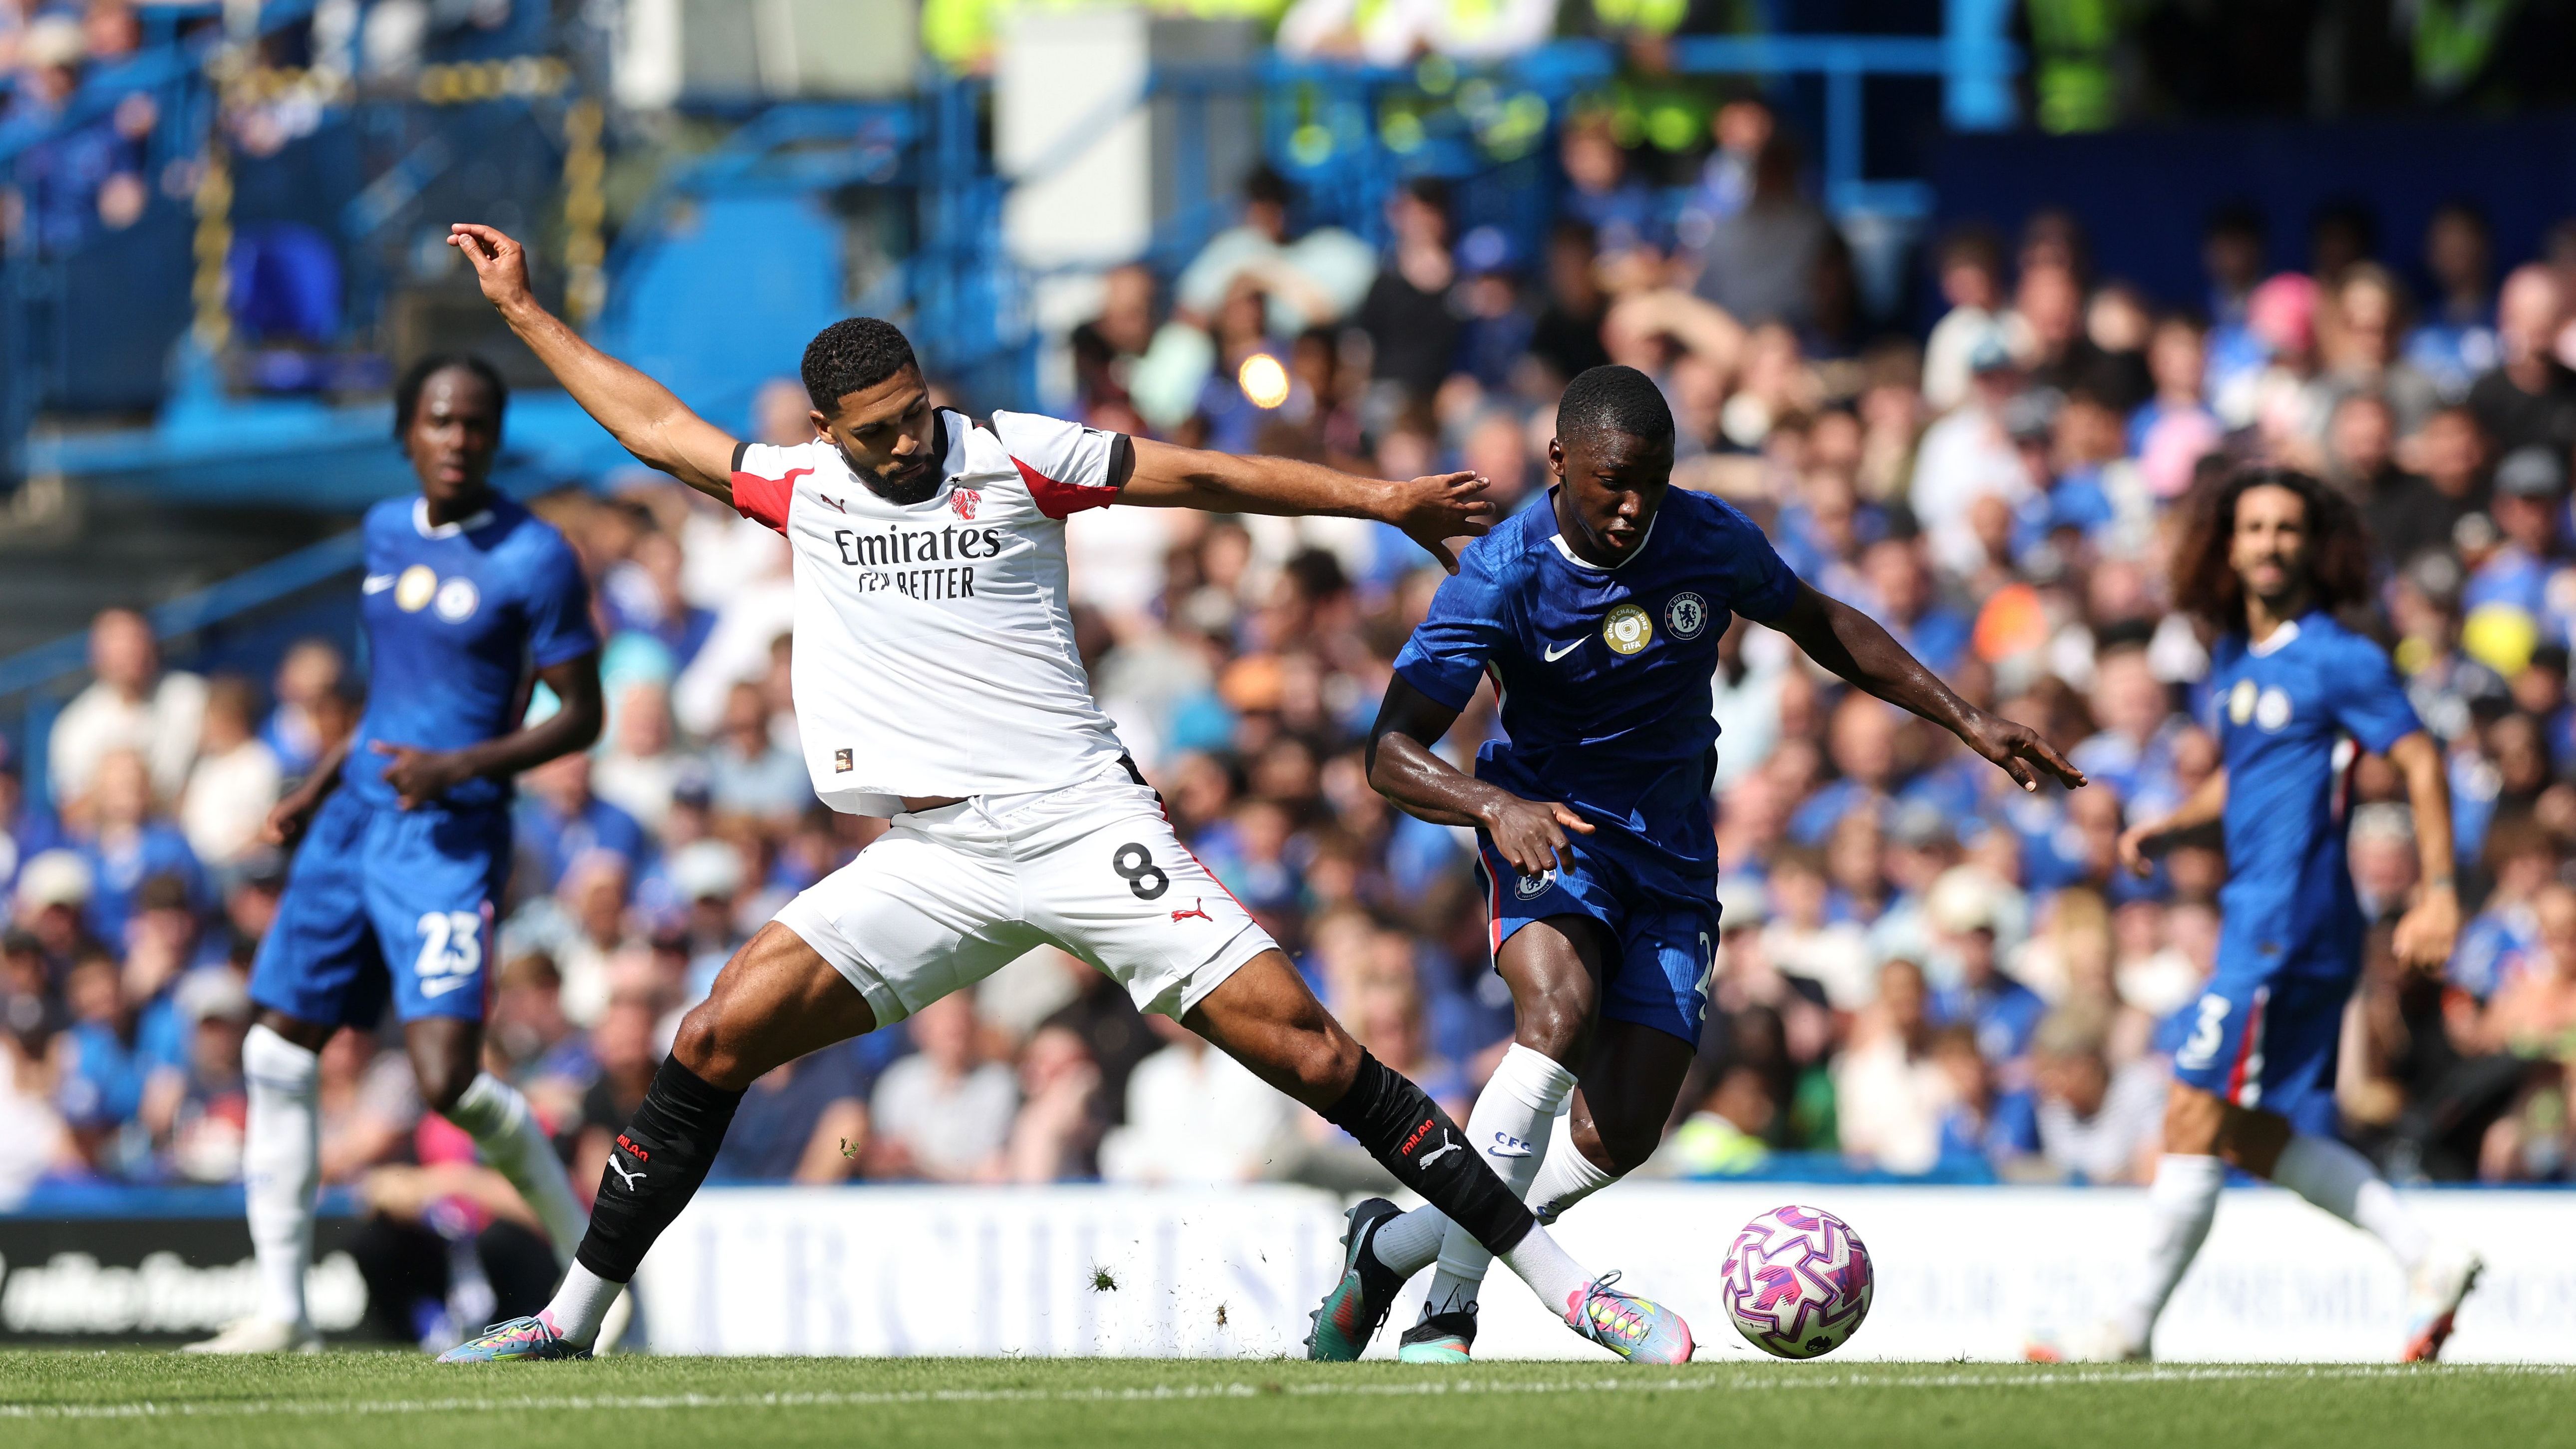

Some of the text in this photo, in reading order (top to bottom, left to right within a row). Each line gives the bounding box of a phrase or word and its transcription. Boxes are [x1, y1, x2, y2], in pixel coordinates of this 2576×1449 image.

[835, 524, 1001, 566] Emirates
[1670, 594, 1697, 607] CHELSEA
[1607, 608, 1648, 640] WORLD CHAMPIONS
[1622, 641, 1641, 651] FIFA
[1113, 843, 1169, 900] 8
[413, 910, 481, 977] 23
[2186, 993, 2232, 1059] 3
[1495, 1132, 1531, 1152] CFC
